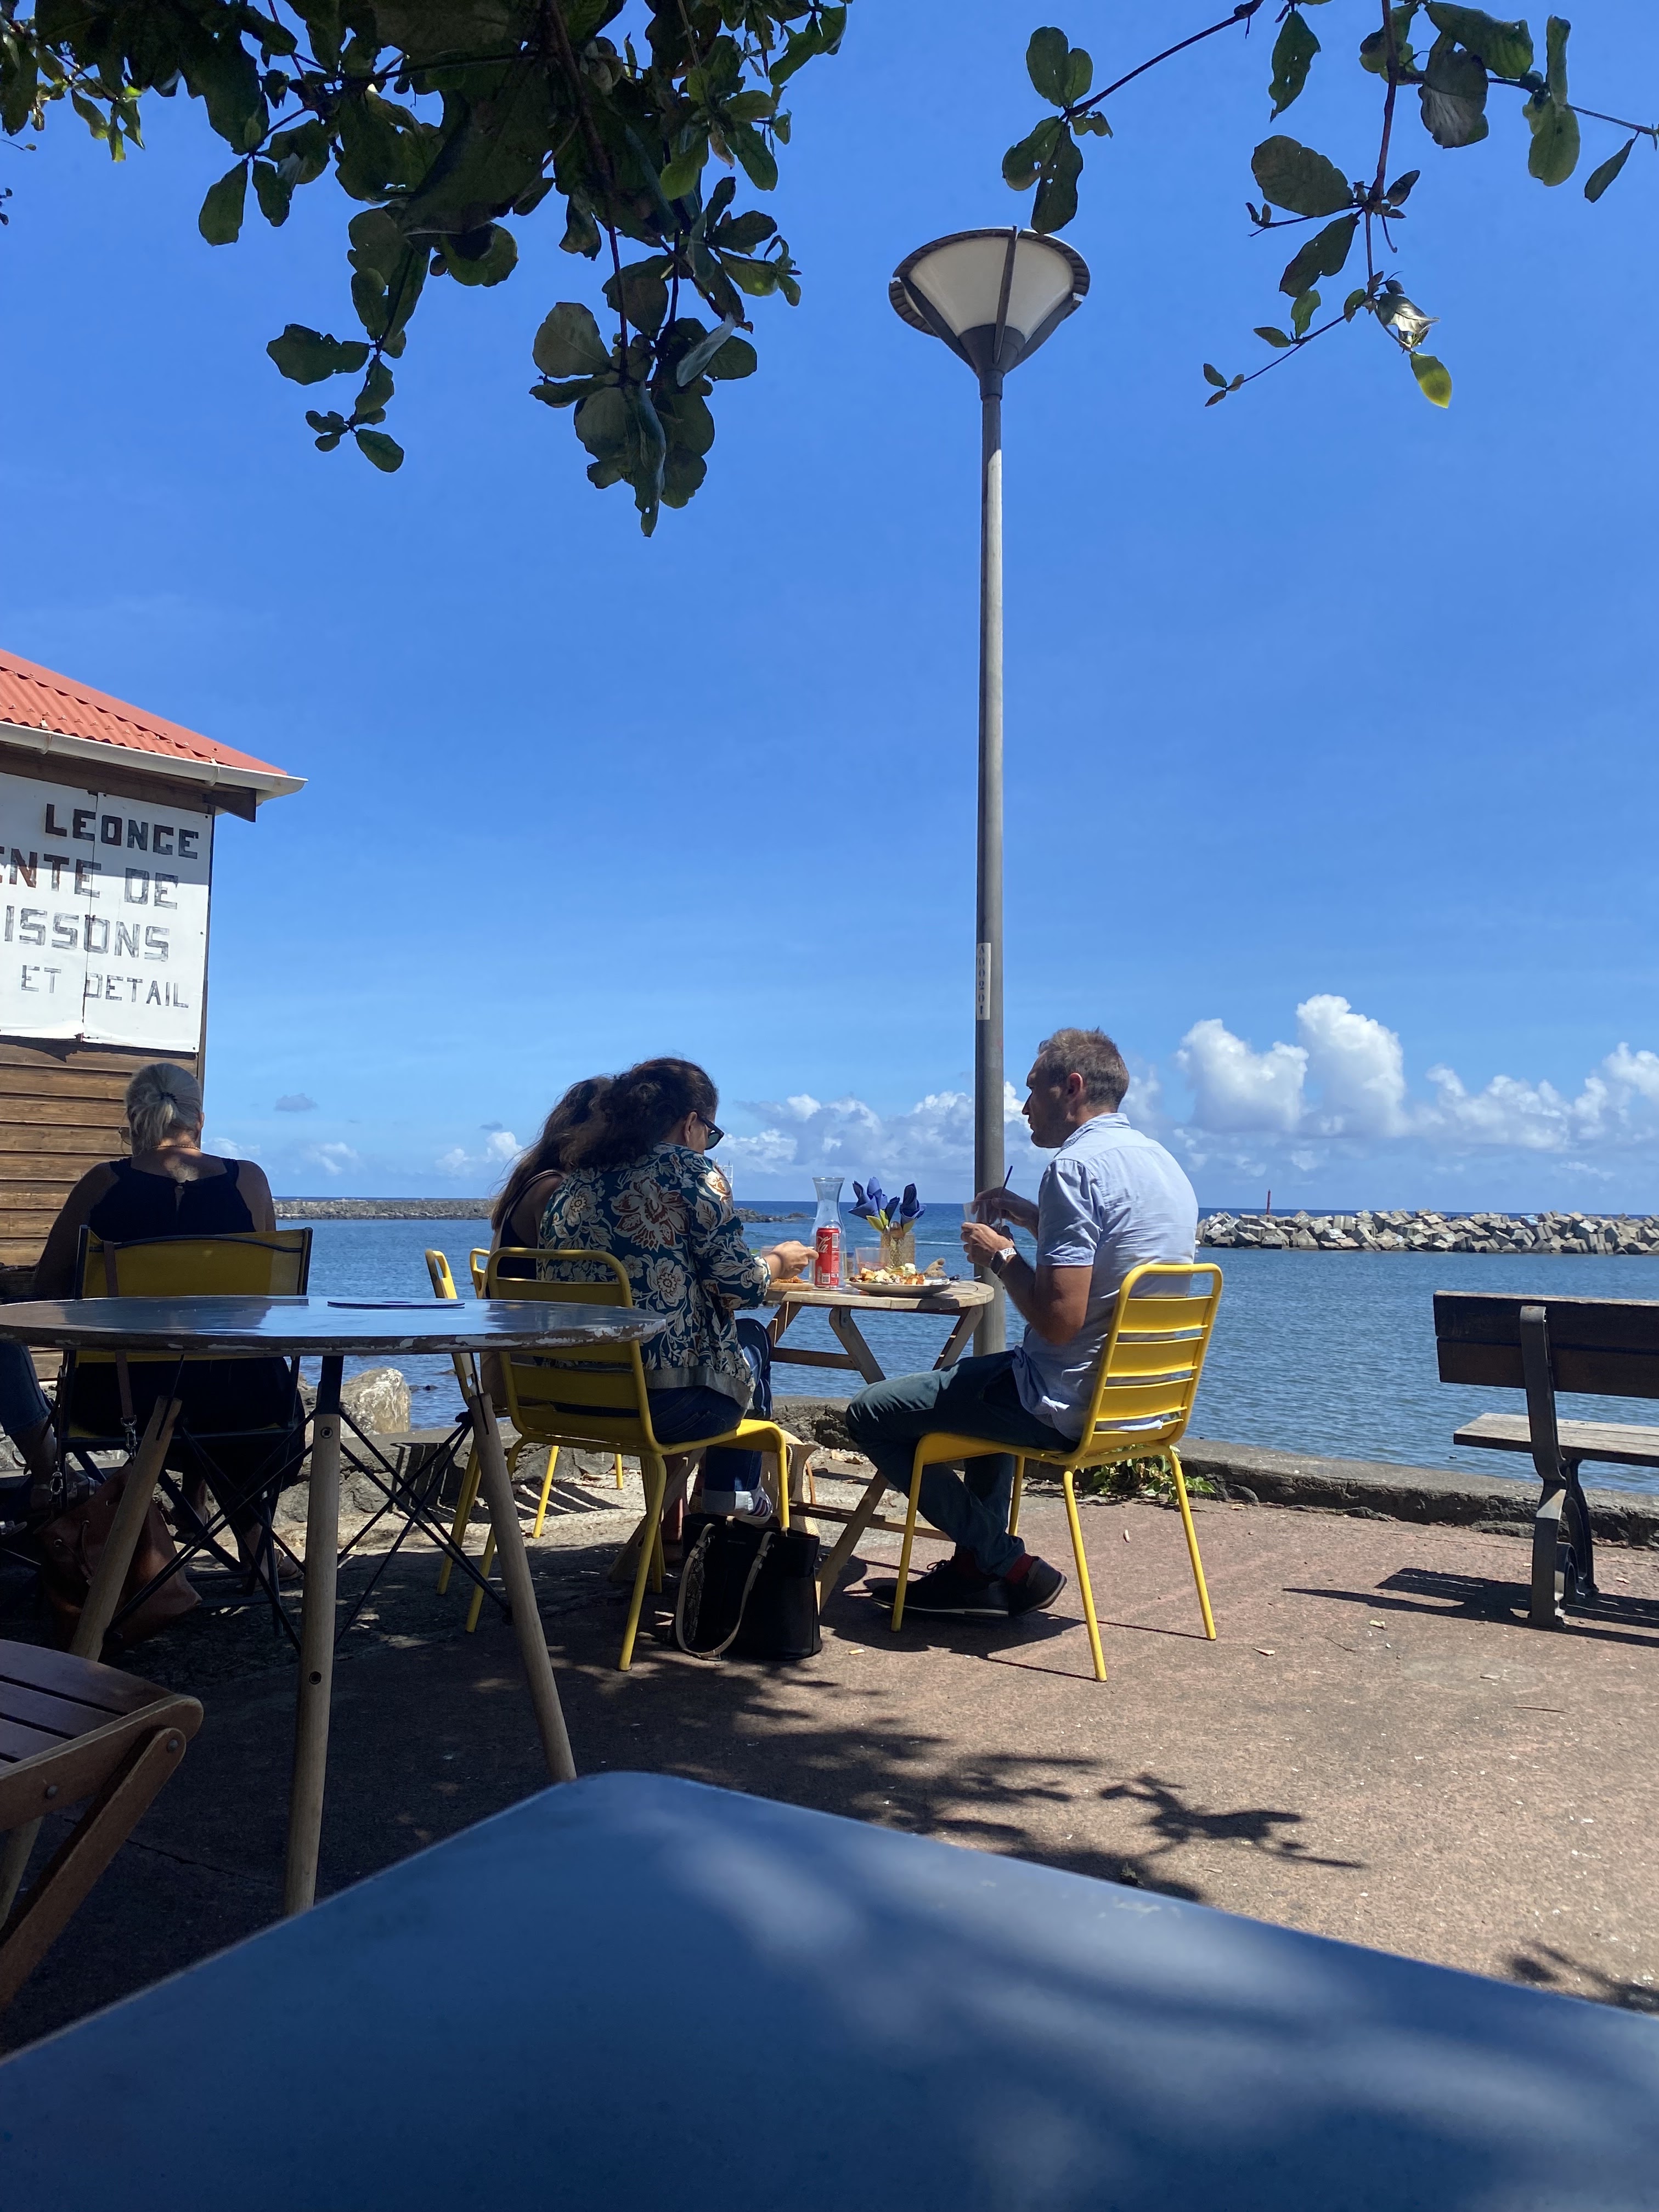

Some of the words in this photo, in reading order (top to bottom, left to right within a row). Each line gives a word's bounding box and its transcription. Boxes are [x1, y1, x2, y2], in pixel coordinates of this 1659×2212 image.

[0, 846, 101, 899] NTE
[124, 867, 178, 910] DE
[4, 905, 170, 962] ISSONS
[21, 964, 61, 994] ET
[84, 972, 189, 1008] DETAIL
